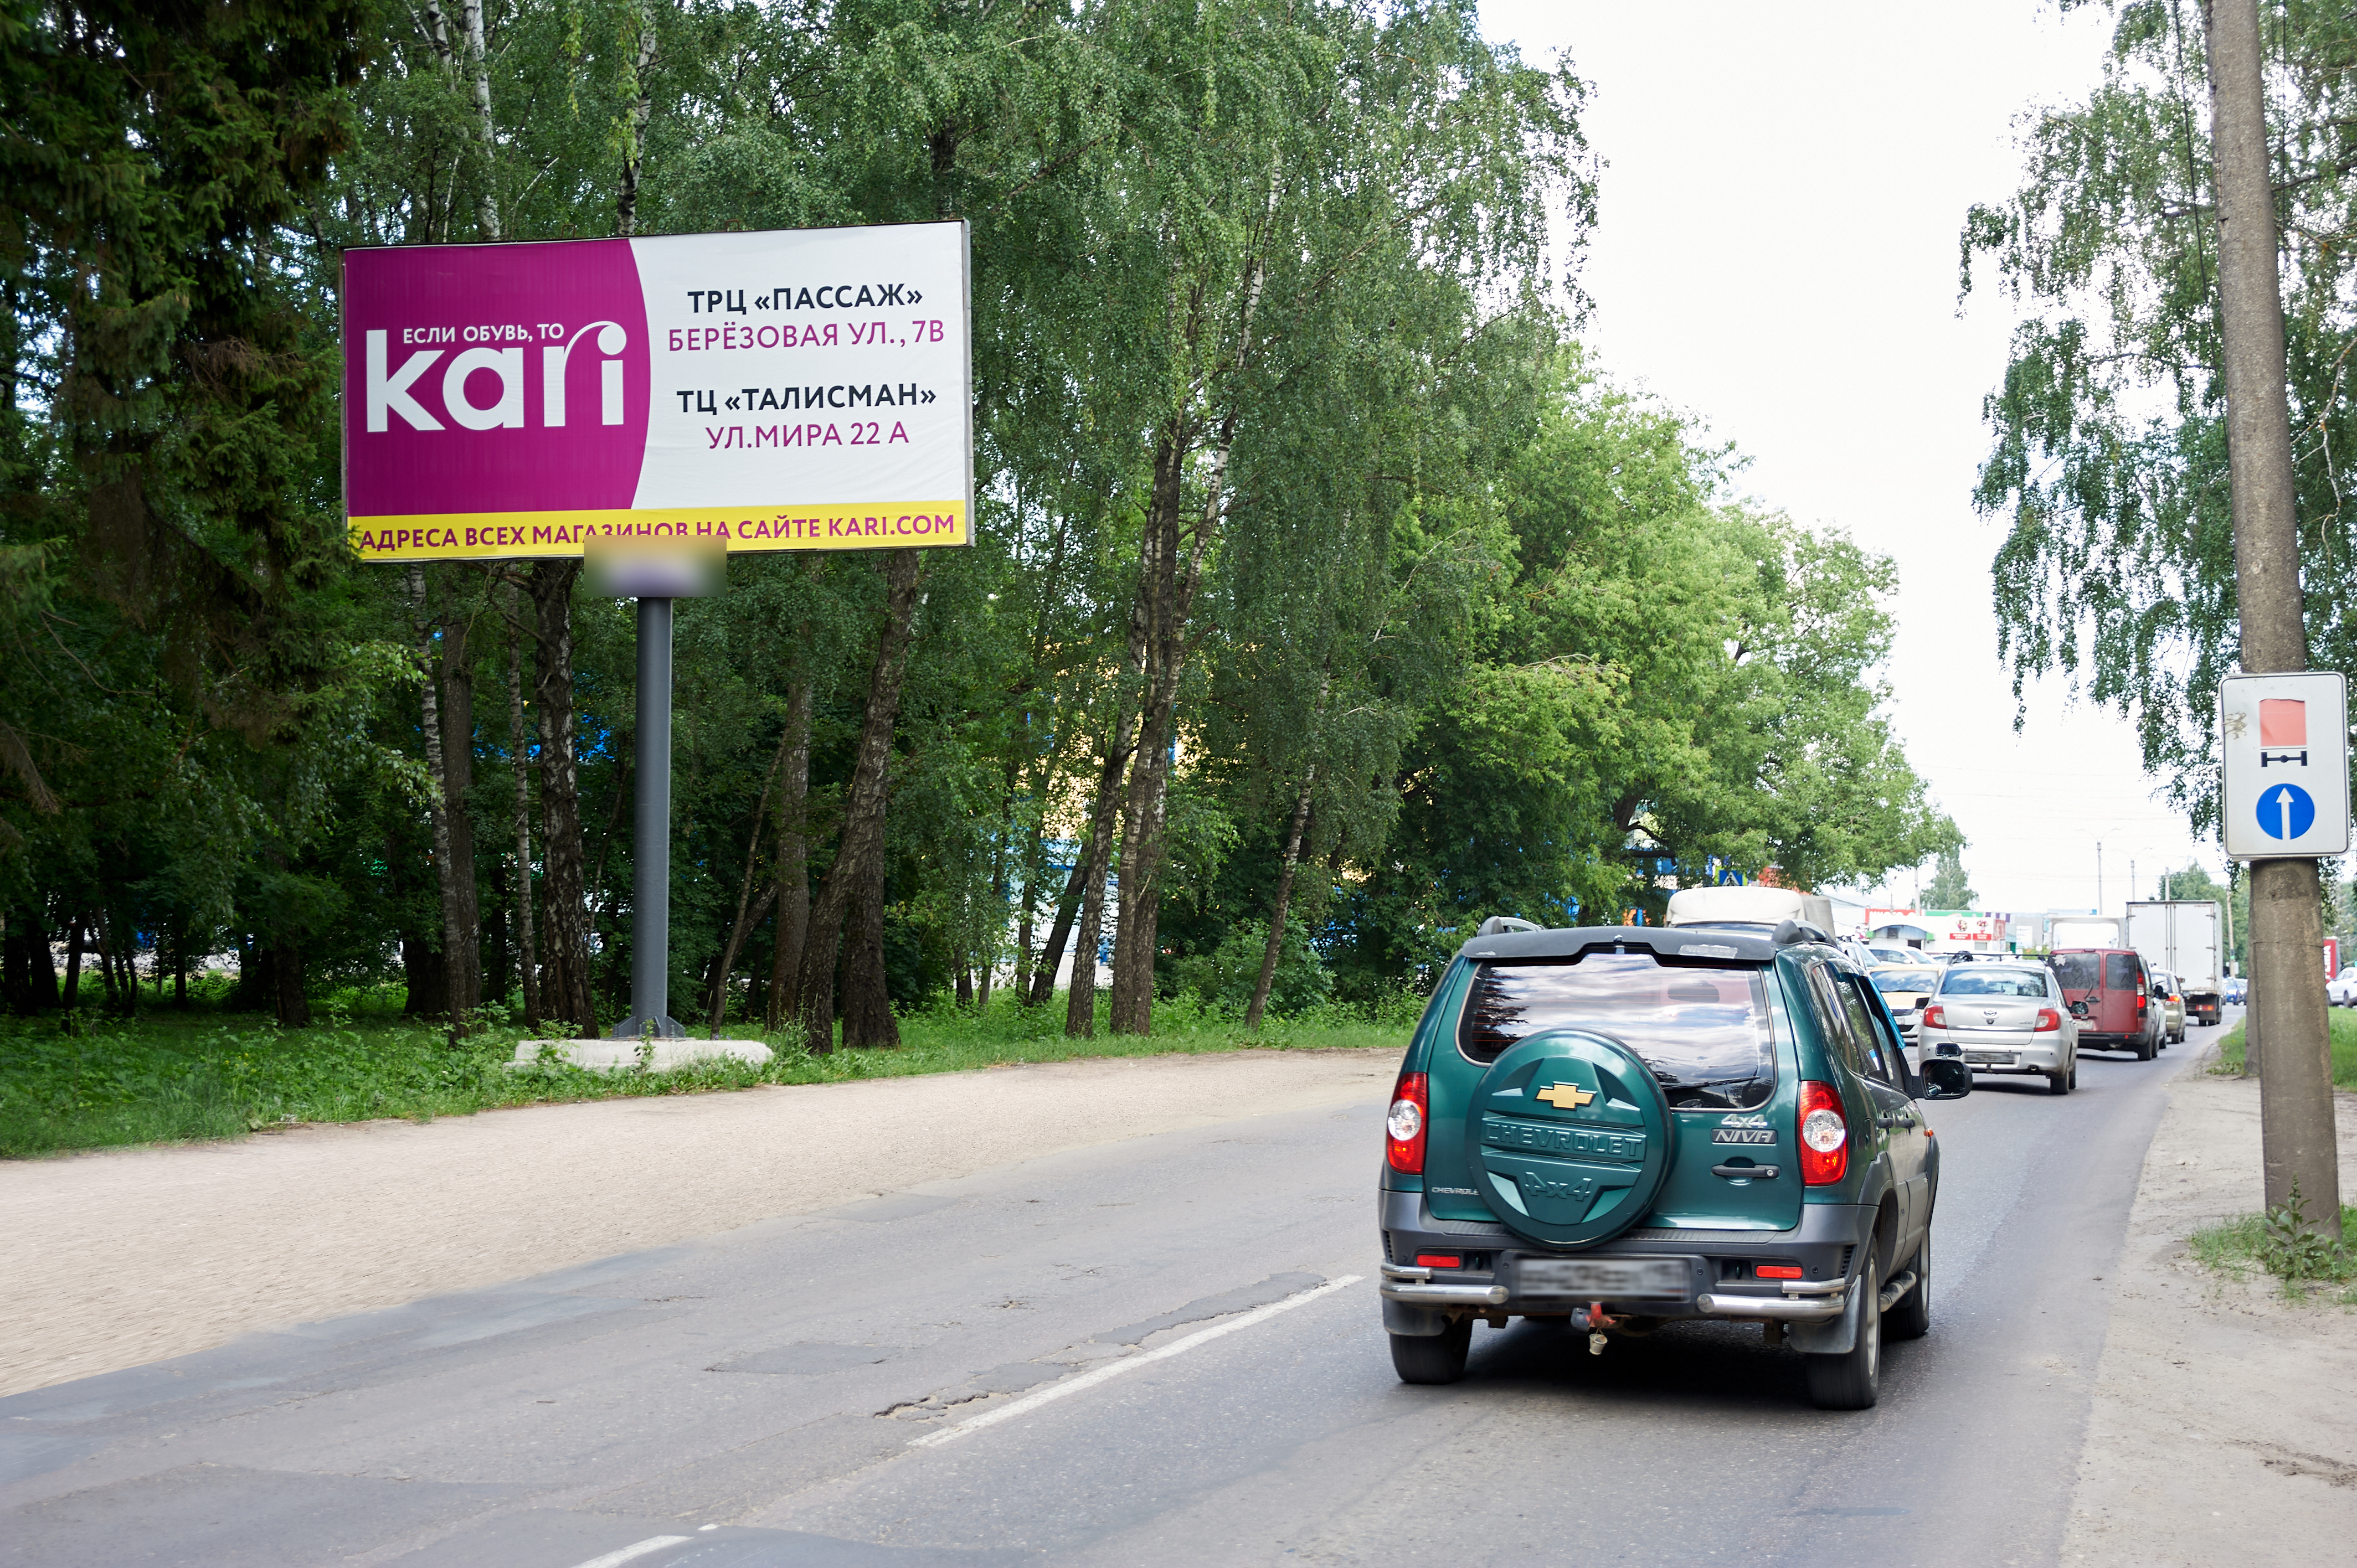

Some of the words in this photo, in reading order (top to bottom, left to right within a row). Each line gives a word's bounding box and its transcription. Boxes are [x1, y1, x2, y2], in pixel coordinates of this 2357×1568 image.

[687, 290, 747, 316] ТРЦ
[754, 283, 923, 311] «ПАССАЖ»
[403, 327, 456, 344] ЕСЛИ
[463, 324, 533, 342] ОБУВЬ,
[537, 323, 564, 339] ТО
[669, 321, 838, 352] БЕРЁЗОВАЯ
[366, 321, 627, 432] kari
[676, 390, 717, 415] ТЦ
[724, 383, 936, 412] «ТАЛИСМАН»
[705, 422, 843, 450] УЛ.МИРА
[850, 421, 881, 445] 22
[888, 421, 910, 444] А
[359, 528, 459, 551] АДРЕСА
[465, 526, 526, 546] ВСЕХ
[697, 521, 732, 539] НА
[738, 515, 821, 539] САЙТЕ
[829, 515, 954, 537] KARI.COM
[1715, 1129, 1773, 1143] NIVA
[1721, 1113, 1768, 1128] 4x4
[1485, 1123, 1643, 1157] CHEVROLET
[1431, 1187, 1480, 1195] CHEVROLE
